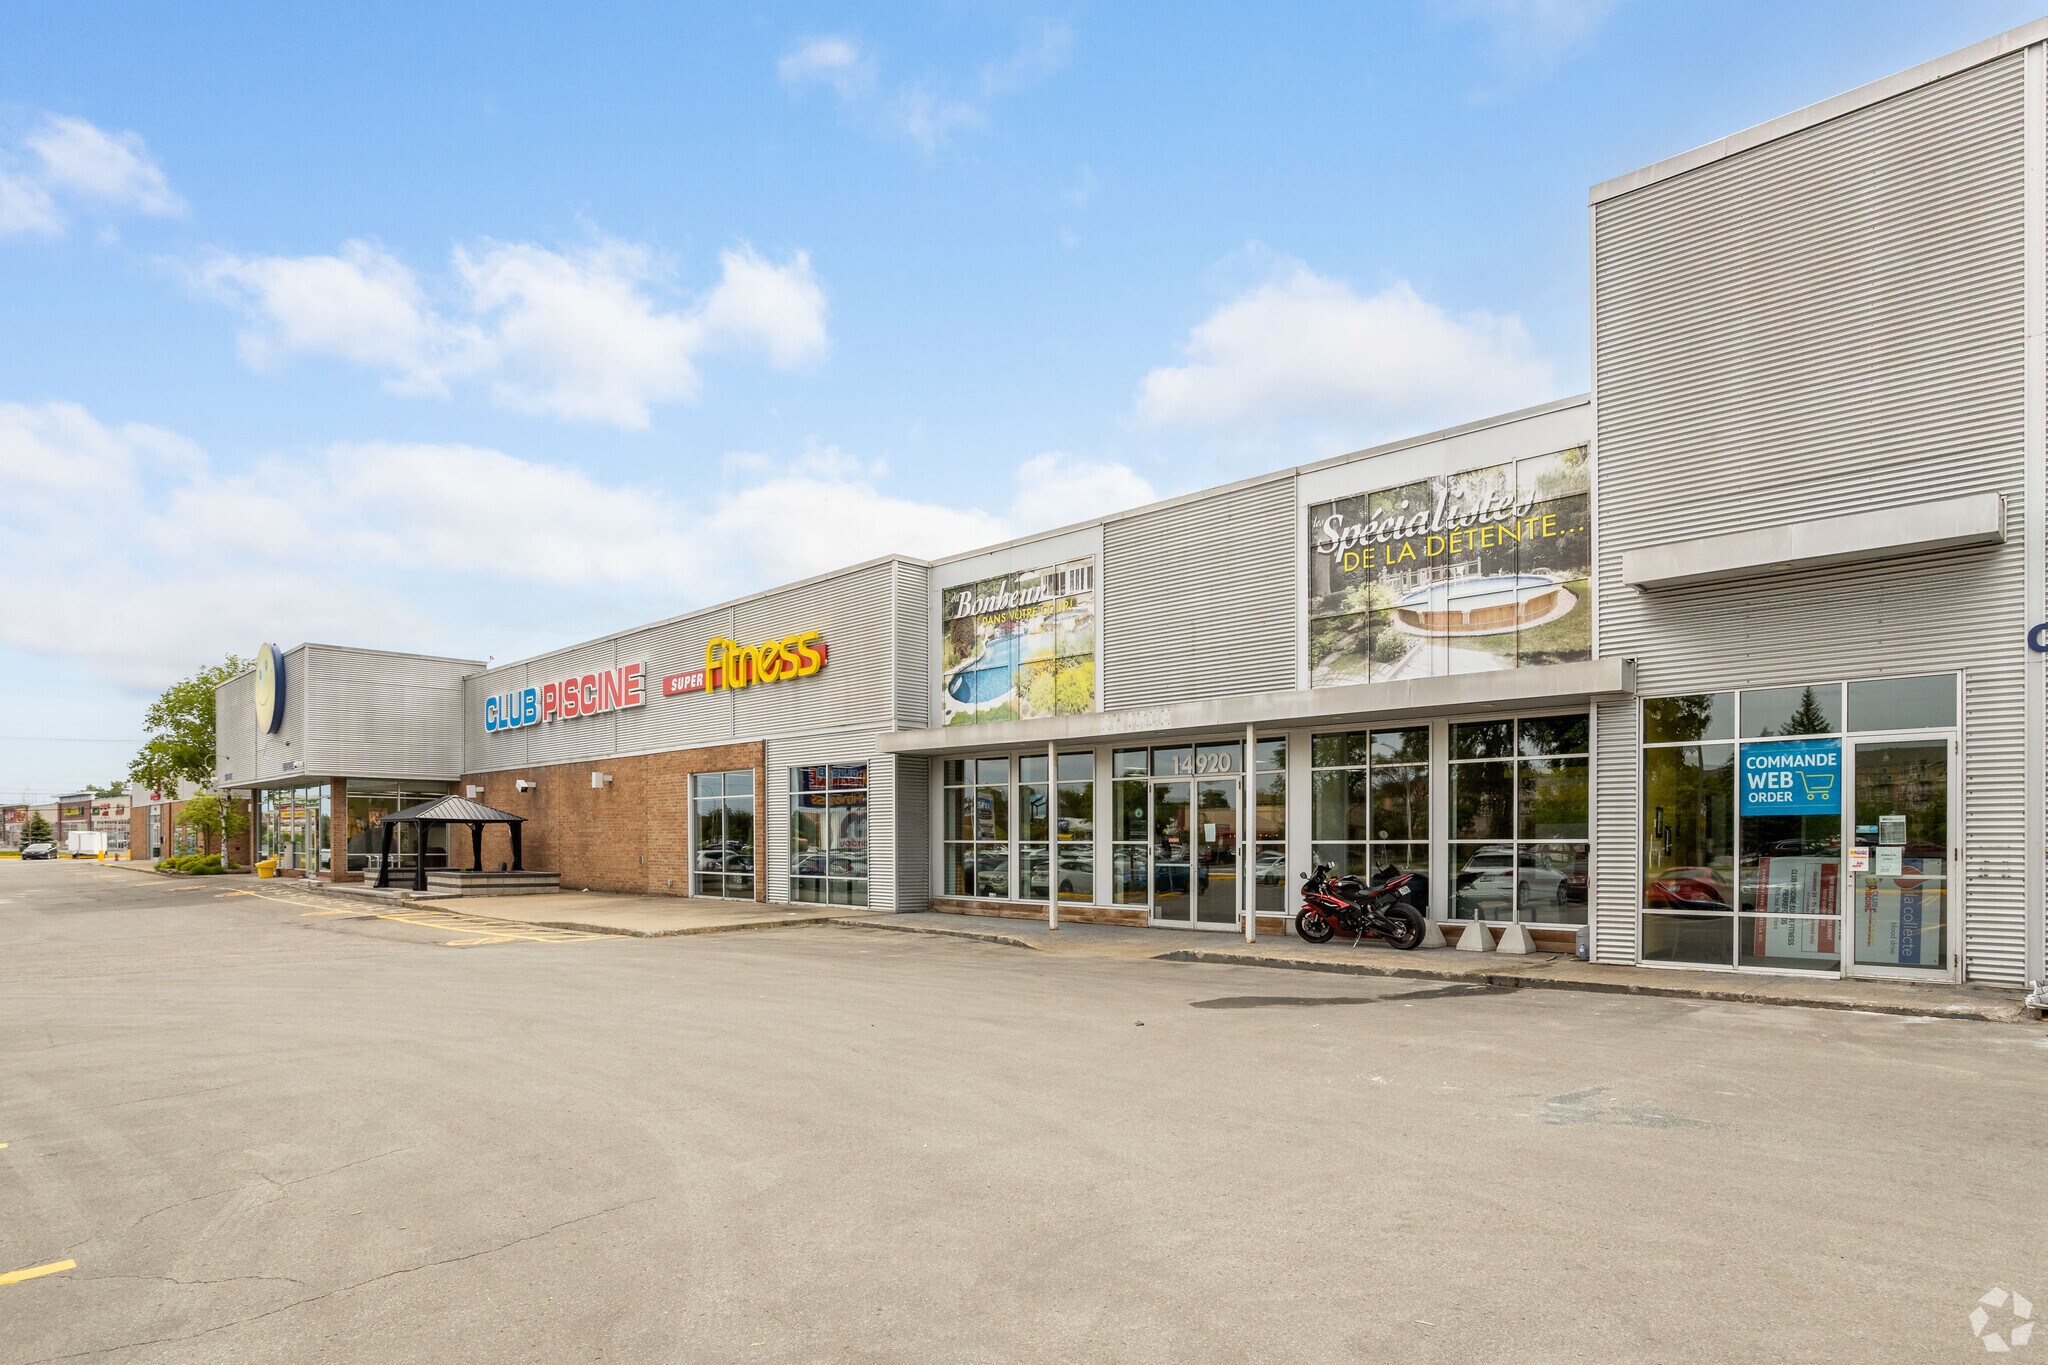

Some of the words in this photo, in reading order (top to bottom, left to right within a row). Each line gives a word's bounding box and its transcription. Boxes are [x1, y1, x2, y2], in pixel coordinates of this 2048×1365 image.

[1317, 486, 1537, 563] Spécialistes
[1343, 548, 1375, 573] DE
[1386, 541, 1417, 566] LA
[1428, 513, 1585, 557] DÉTENTE...
[954, 579, 1047, 619] Bonheur
[981, 614, 1006, 627] DANS
[1009, 606, 1038, 621] VOTRE
[1041, 600, 1073, 616] COUR!
[671, 673, 704, 692] SUPER
[485, 686, 541, 733] CLUB
[543, 661, 646, 724] PISCINE
[1172, 752, 1232, 775] 14920
[1746, 753, 1837, 770] COMMANDE
[1747, 771, 1794, 789] WEB
[1748, 791, 1793, 803] ORDER
[1903, 893, 1919, 904] la
[1787, 924, 1795, 946] FITNESS
[1902, 906, 1919, 956] collecte
[1889, 940, 1897, 955] drive
